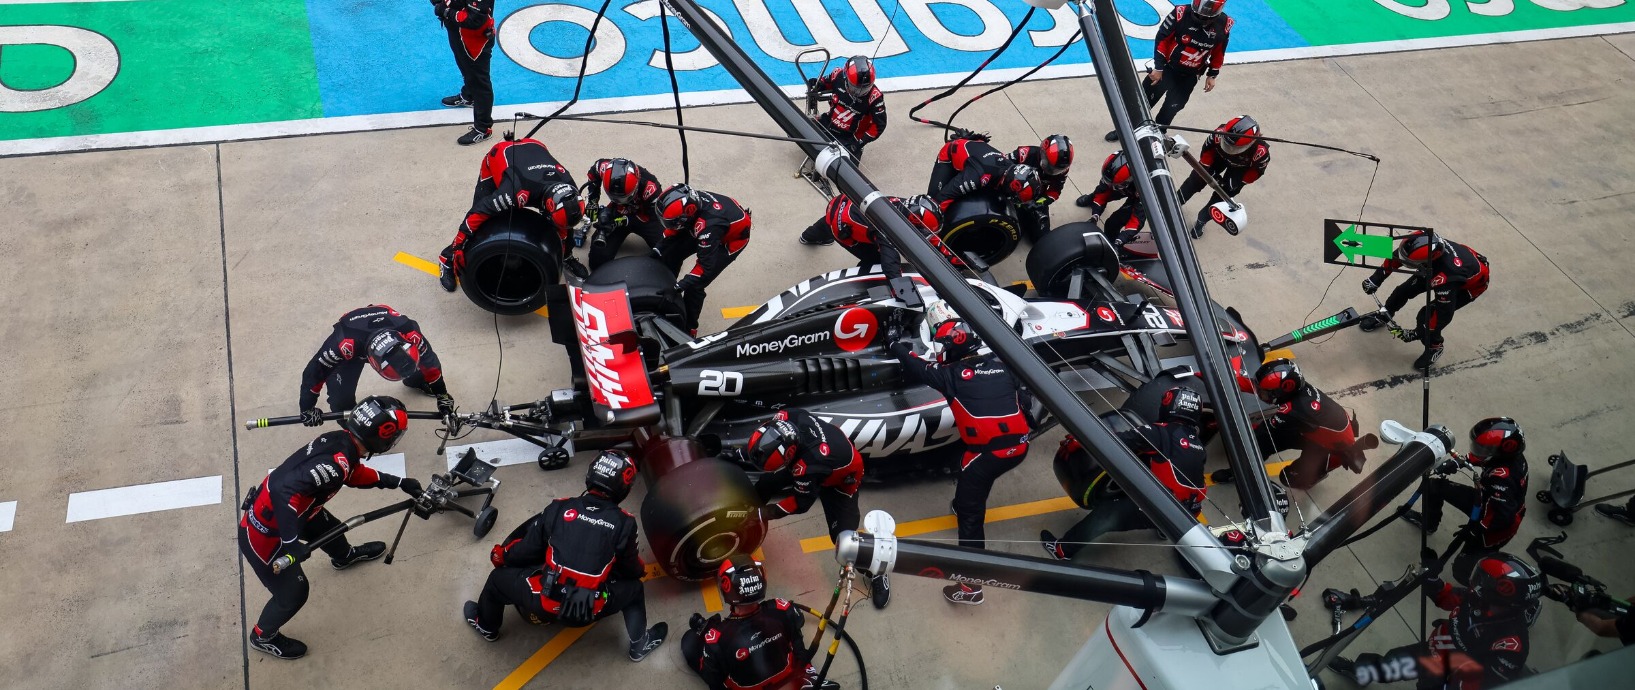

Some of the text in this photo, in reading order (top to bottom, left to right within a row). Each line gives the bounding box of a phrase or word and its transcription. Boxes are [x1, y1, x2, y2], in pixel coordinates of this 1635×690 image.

[736, 330, 830, 358] MoneyGram
[973, 368, 1005, 377] MoneyGram
[697, 370, 744, 397] 20
[353, 408, 373, 427] Angels
[359, 401, 376, 419] Palm
[593, 461, 617, 477] Angels
[599, 455, 618, 469] Palm
[577, 513, 615, 530] MoneyGram
[739, 582, 763, 595] Angels
[740, 575, 760, 587] Palm
[949, 572, 1022, 591] MoneyGram
[748, 632, 782, 654] MoneyGram
